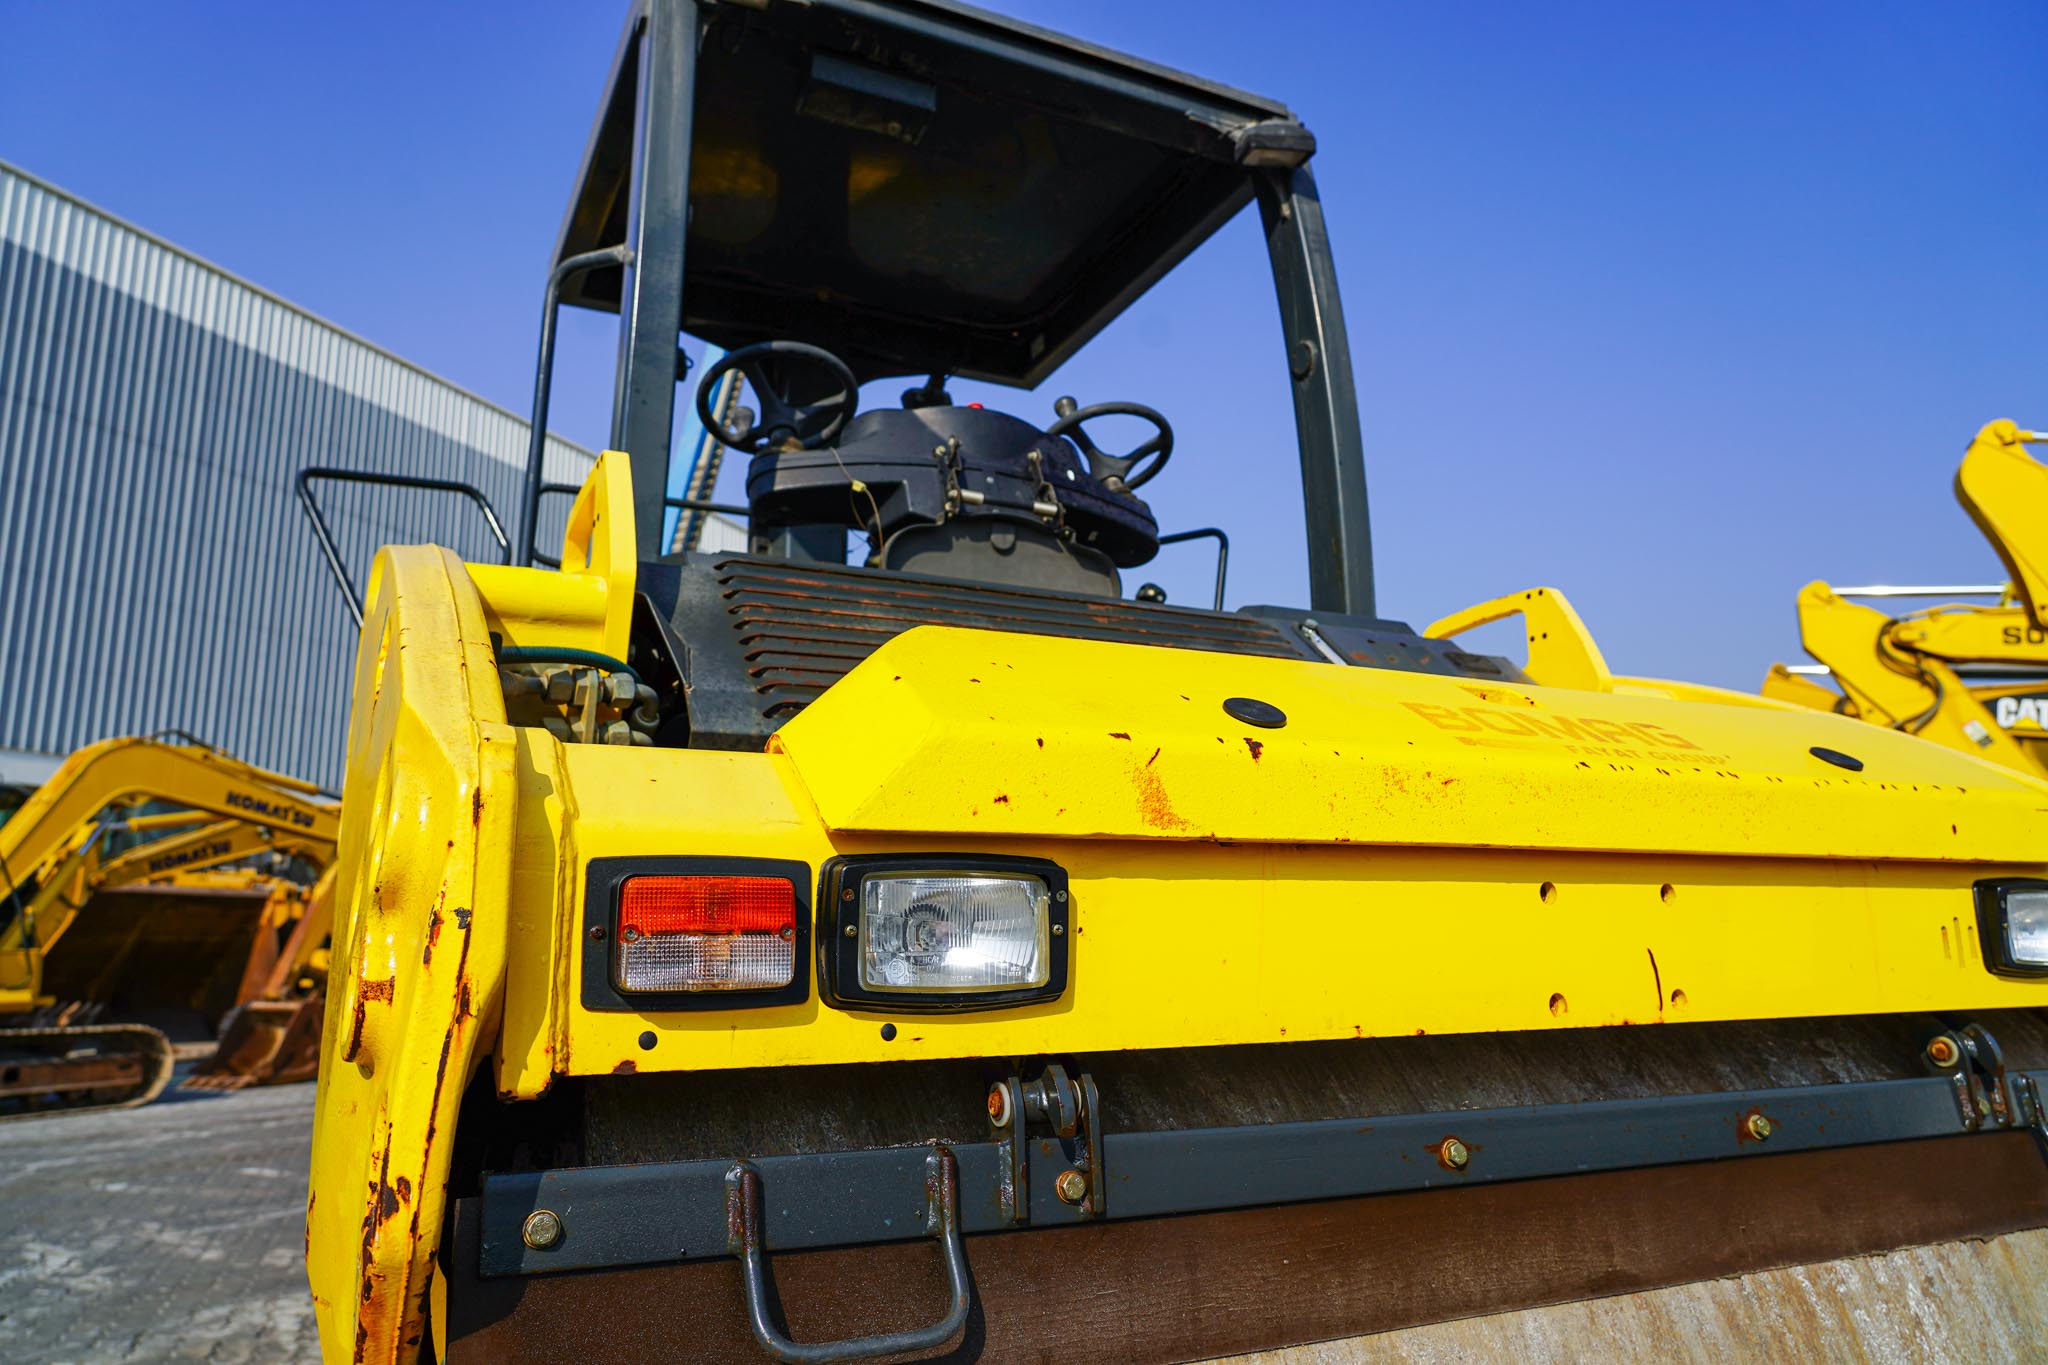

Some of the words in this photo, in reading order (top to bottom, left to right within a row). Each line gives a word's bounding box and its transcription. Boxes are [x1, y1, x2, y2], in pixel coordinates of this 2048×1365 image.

[1399, 702, 1704, 751] BOMAG
[1997, 696, 2048, 731] CAT
[226, 790, 315, 827] KOMATSU
[150, 840, 231, 872] KOMATSU
